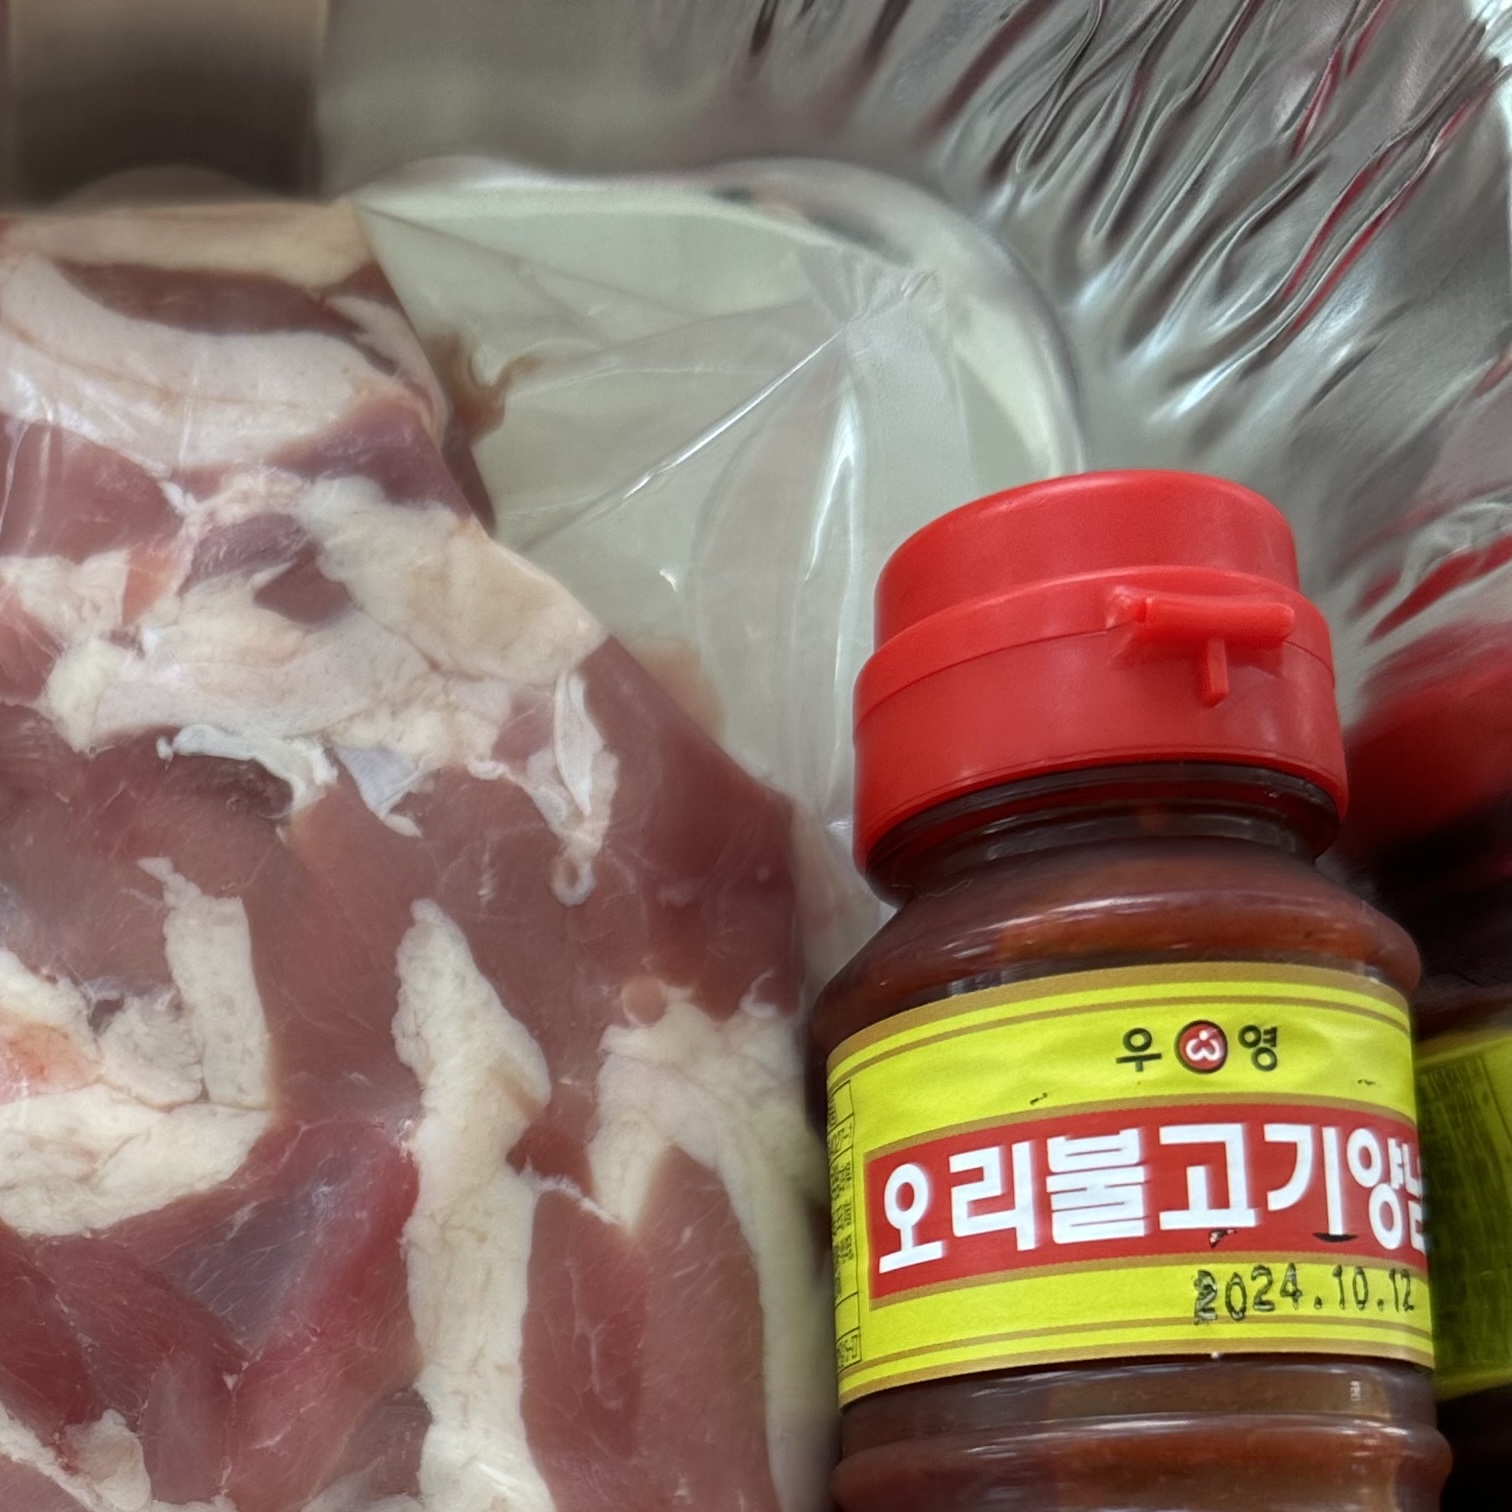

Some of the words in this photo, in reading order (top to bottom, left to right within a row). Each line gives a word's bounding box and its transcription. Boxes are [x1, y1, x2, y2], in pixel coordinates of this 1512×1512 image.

[1115, 1027, 1163, 1073] 우
[1238, 1024, 1278, 1072] 영
[1193, 1262, 1415, 1325] 2024.10.12
